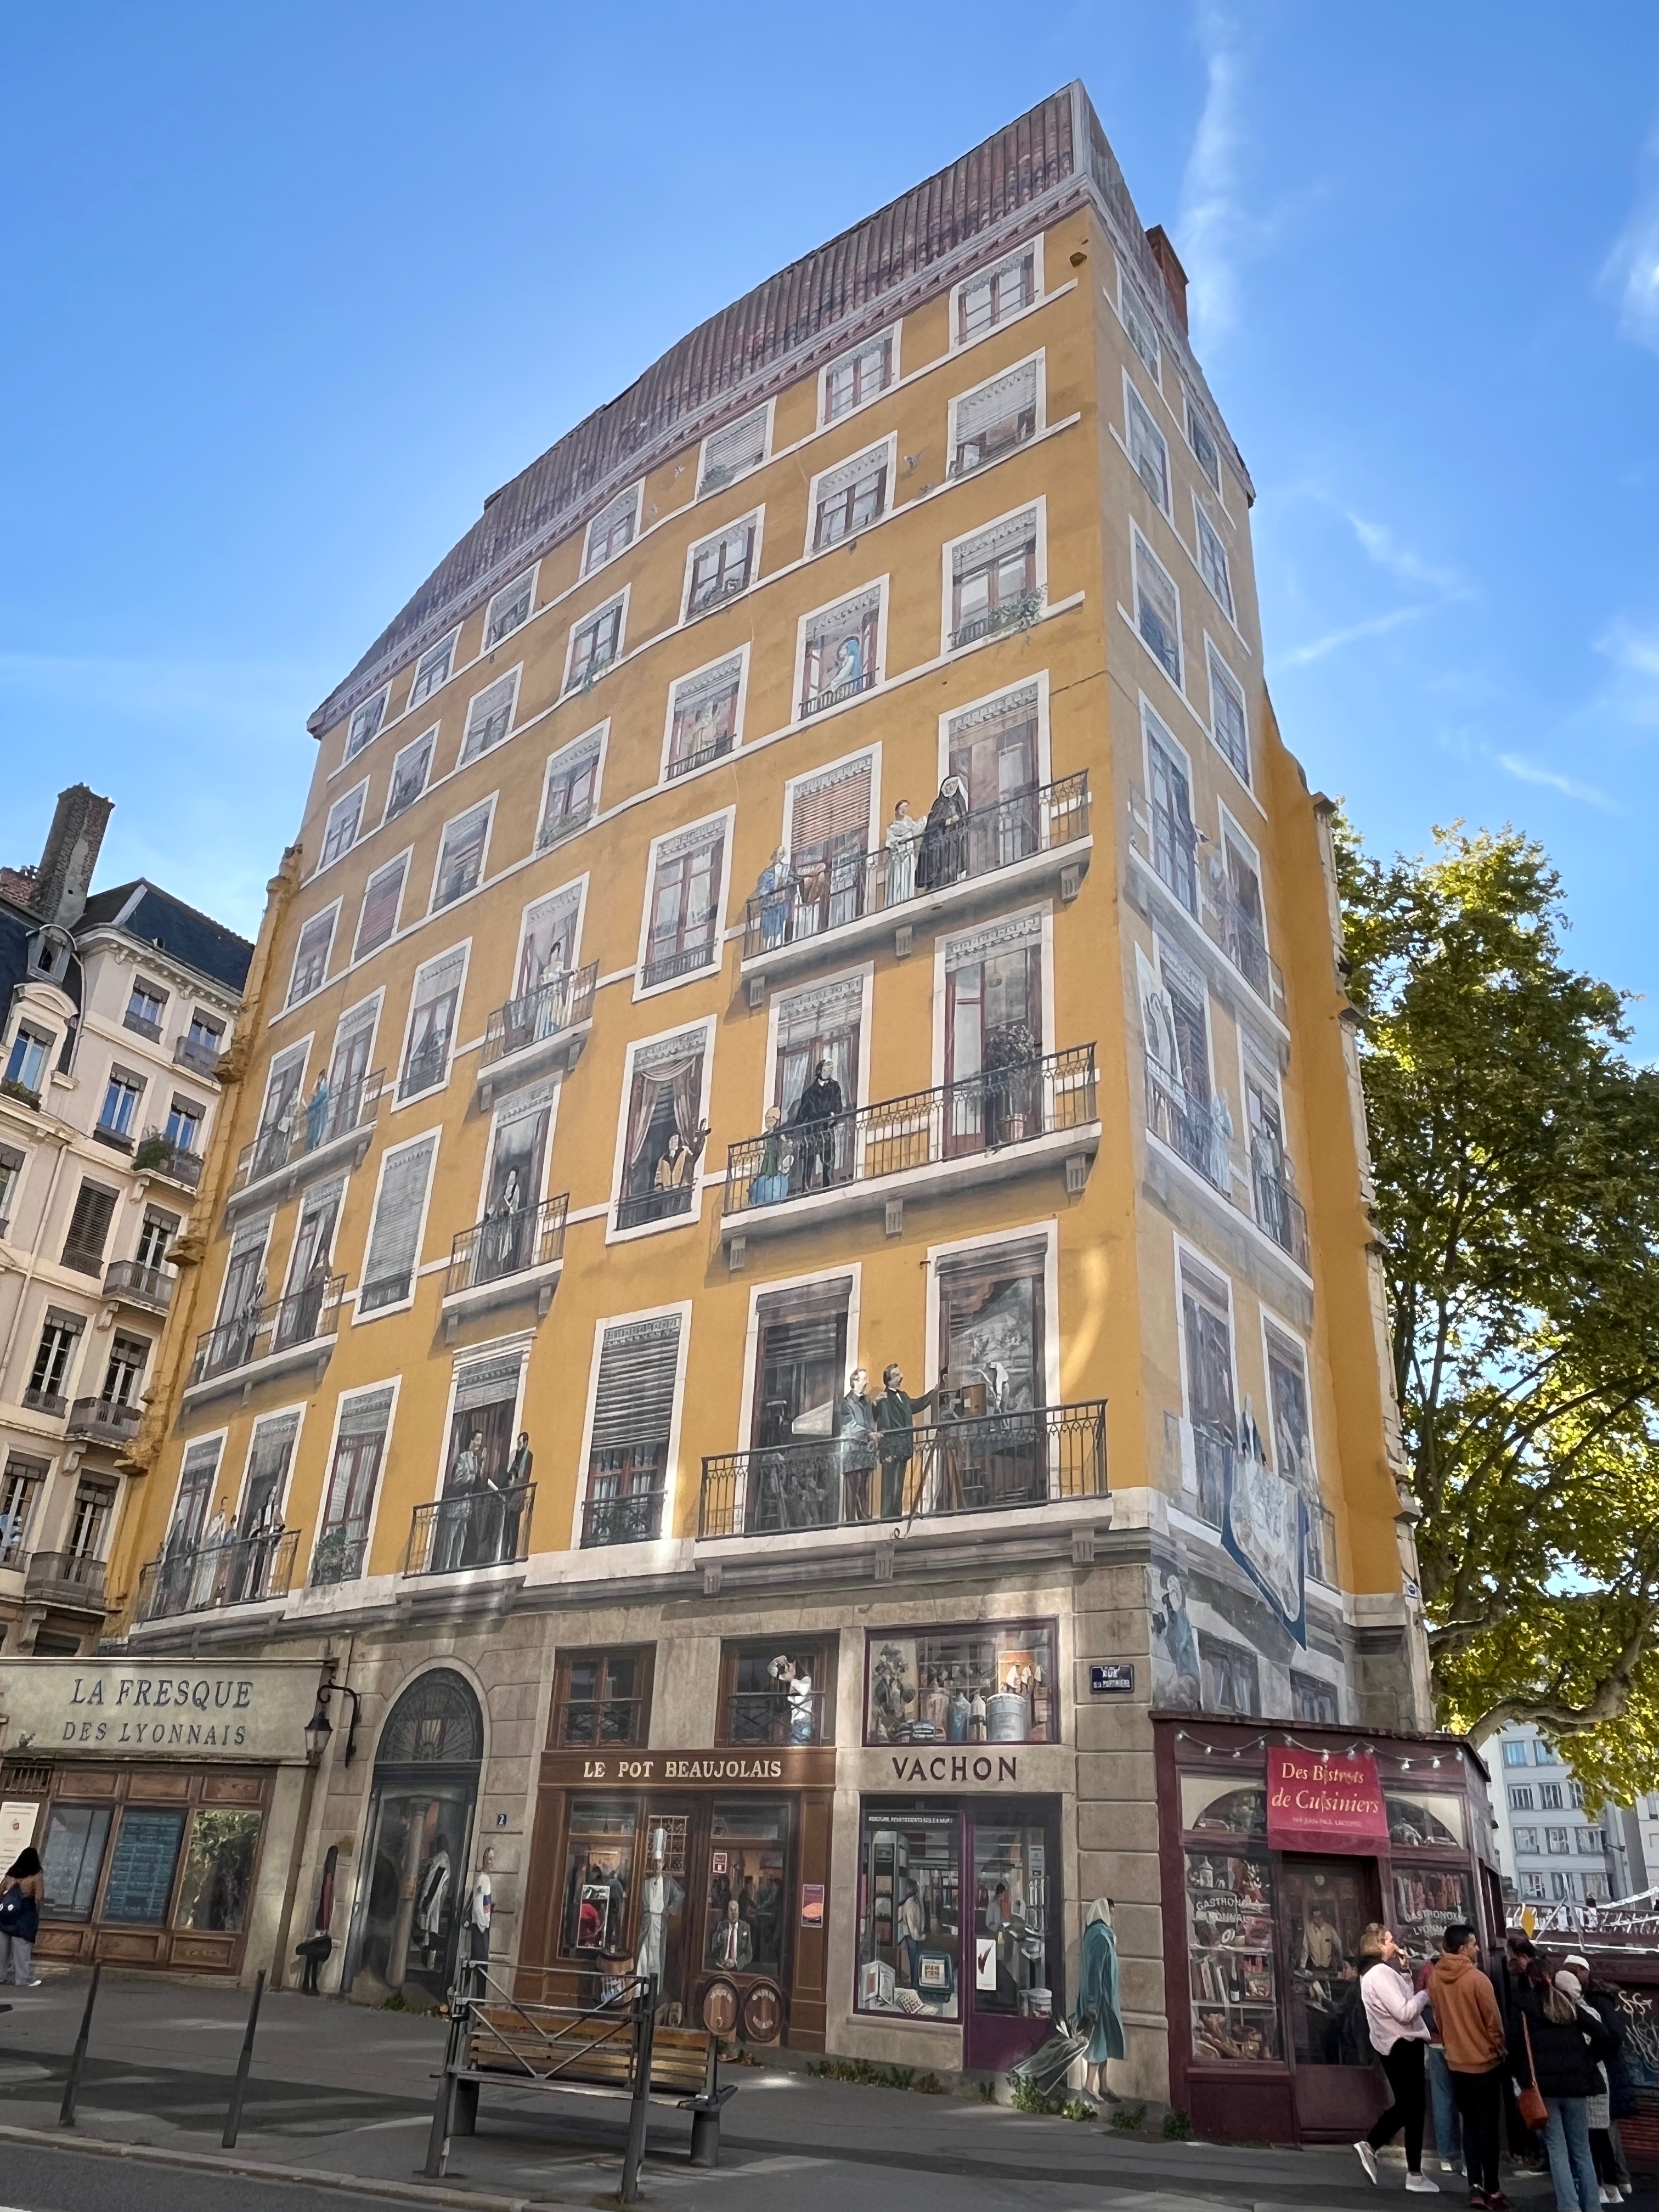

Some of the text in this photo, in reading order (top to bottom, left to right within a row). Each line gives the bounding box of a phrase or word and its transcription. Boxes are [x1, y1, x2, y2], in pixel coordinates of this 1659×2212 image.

[70, 1679, 253, 1711] LA FRESQUE
[63, 1722, 246, 1746] DES LYONNAIS
[584, 1760, 781, 1778] LE POT BEAUJOLAIS
[892, 1756, 1017, 1781] VACHON
[1282, 1763, 1308, 1780] Des
[1272, 1787, 1379, 1813] de Cuisiniers
[499, 1814, 505, 1825] 2
